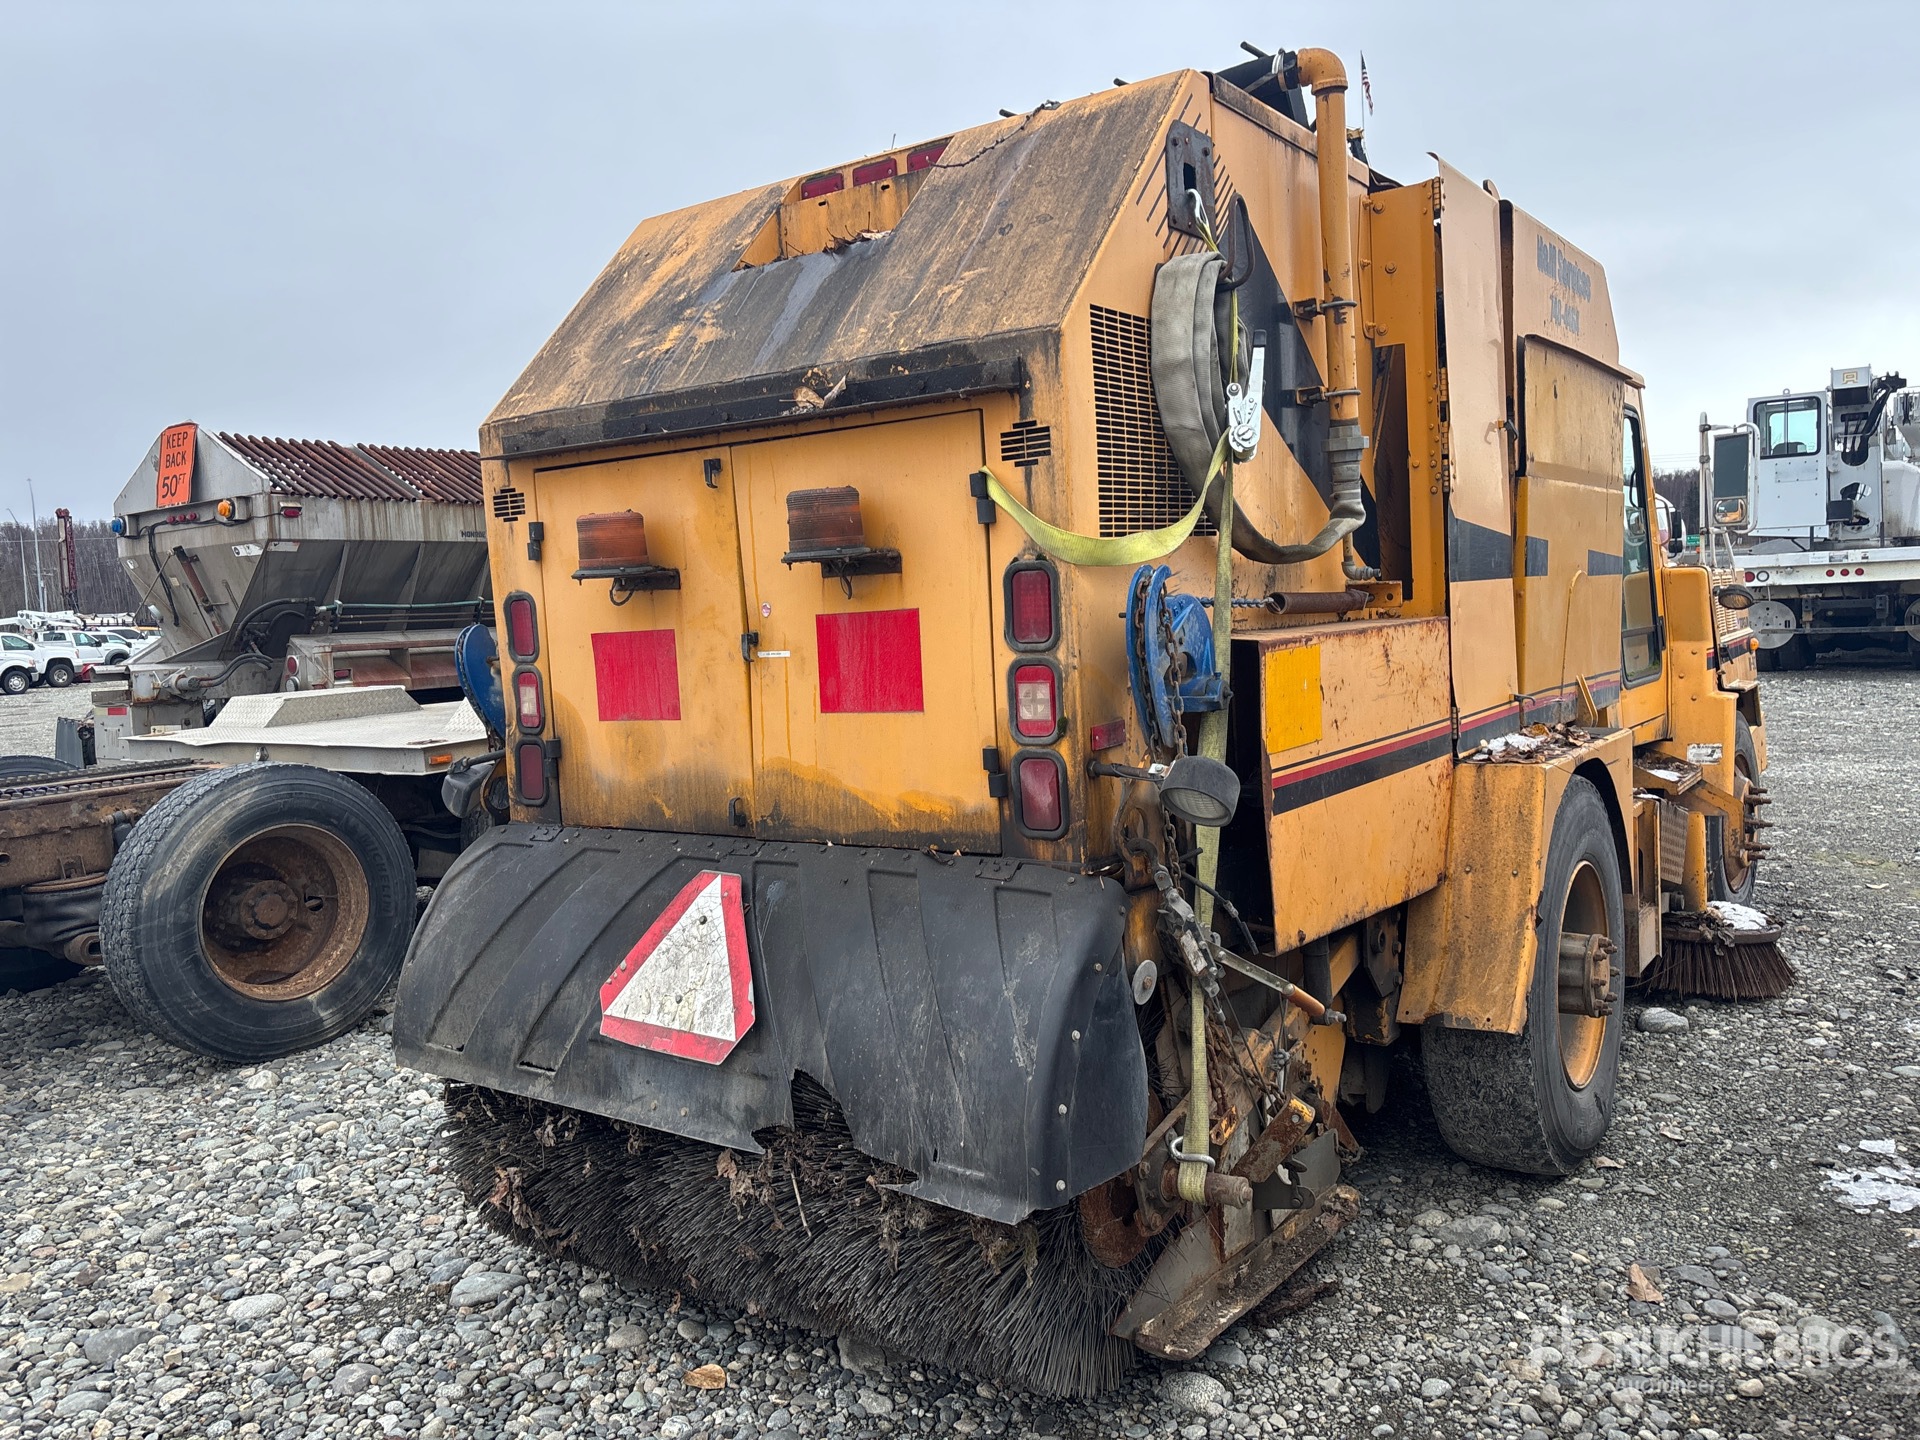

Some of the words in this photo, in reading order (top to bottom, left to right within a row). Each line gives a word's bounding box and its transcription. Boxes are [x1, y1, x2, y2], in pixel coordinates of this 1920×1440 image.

[166, 431, 188, 450] KEEP
[165, 450, 187, 469] BACK
[161, 474, 178, 499] 50
[360, 832, 395, 919] MICHELIN
